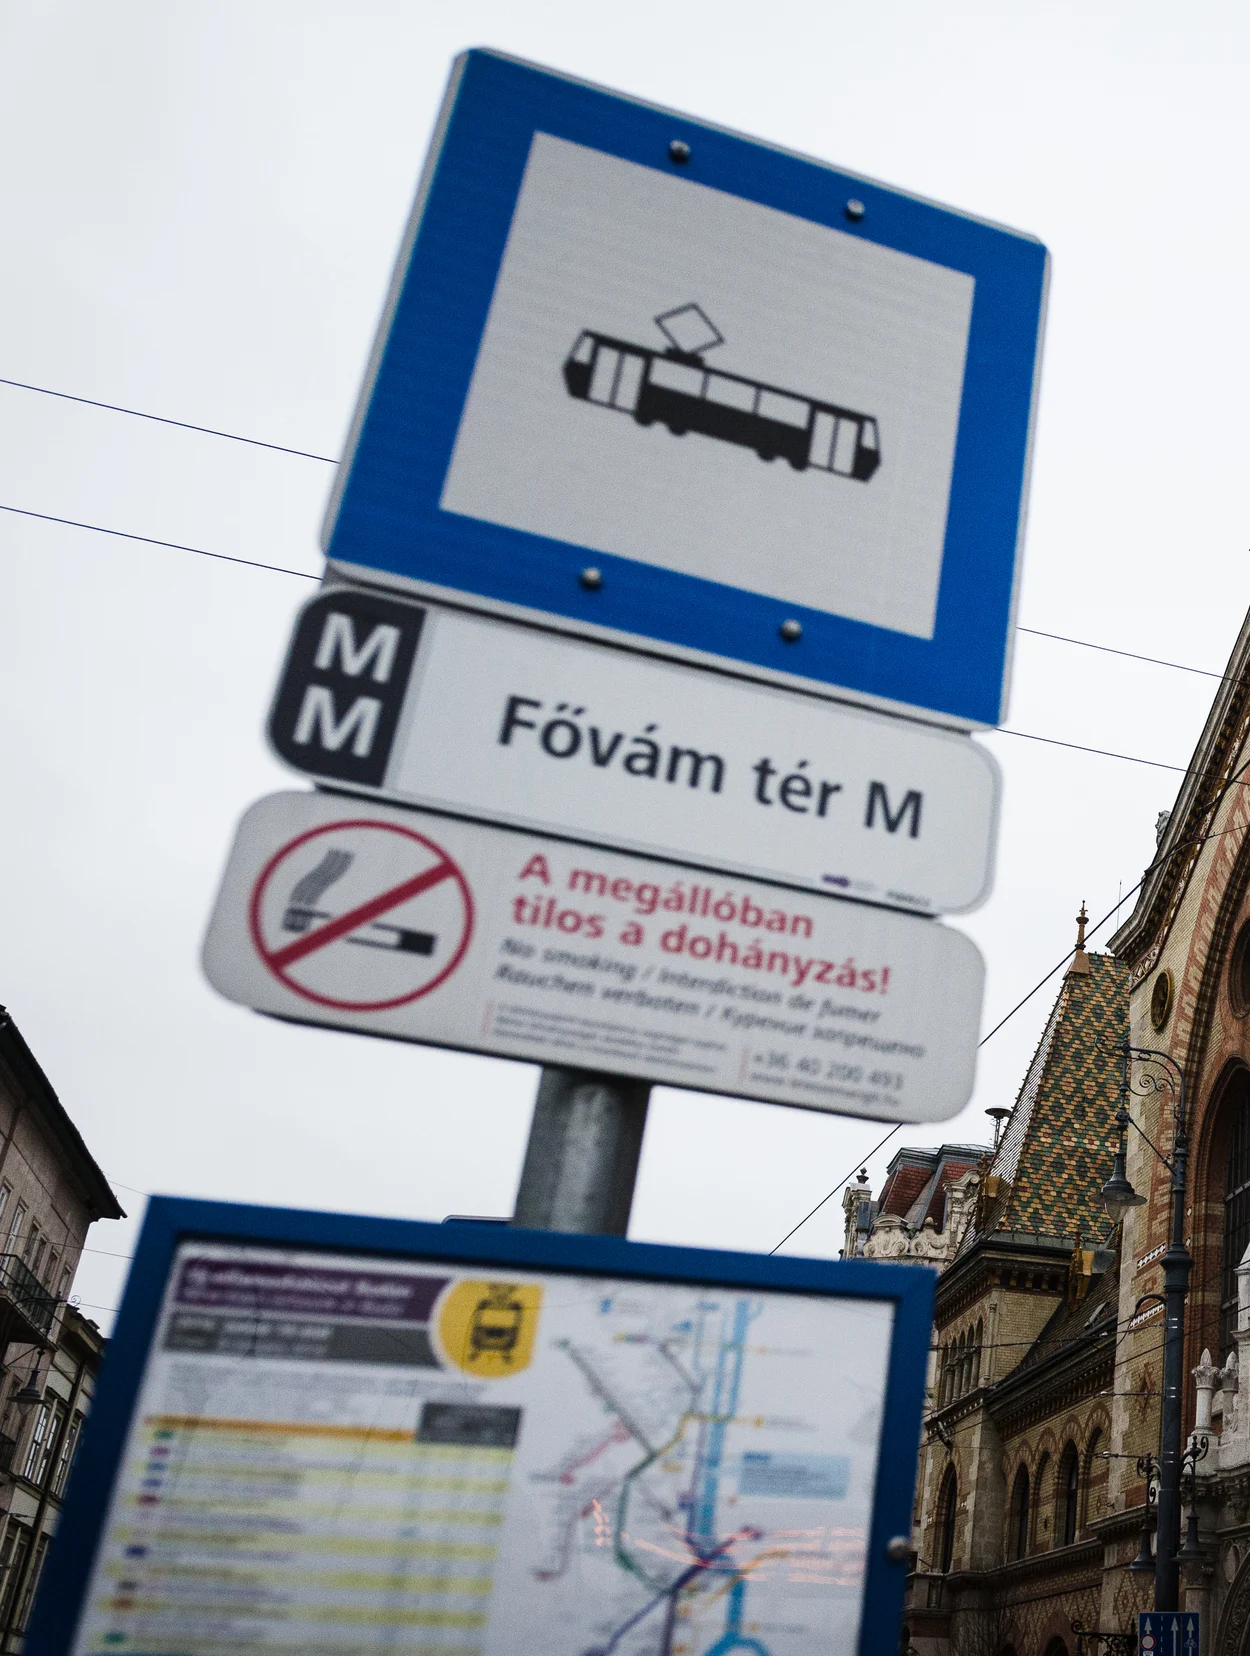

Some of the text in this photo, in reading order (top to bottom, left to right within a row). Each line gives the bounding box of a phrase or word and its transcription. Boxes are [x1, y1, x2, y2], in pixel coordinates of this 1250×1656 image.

[314, 611, 400, 684] M
[292, 684, 382, 758] M
[498, 694, 923, 839] Fővám tér M
[518, 853, 814, 939] A megállóban
[511, 893, 892, 996] tilos a dohányzás!
